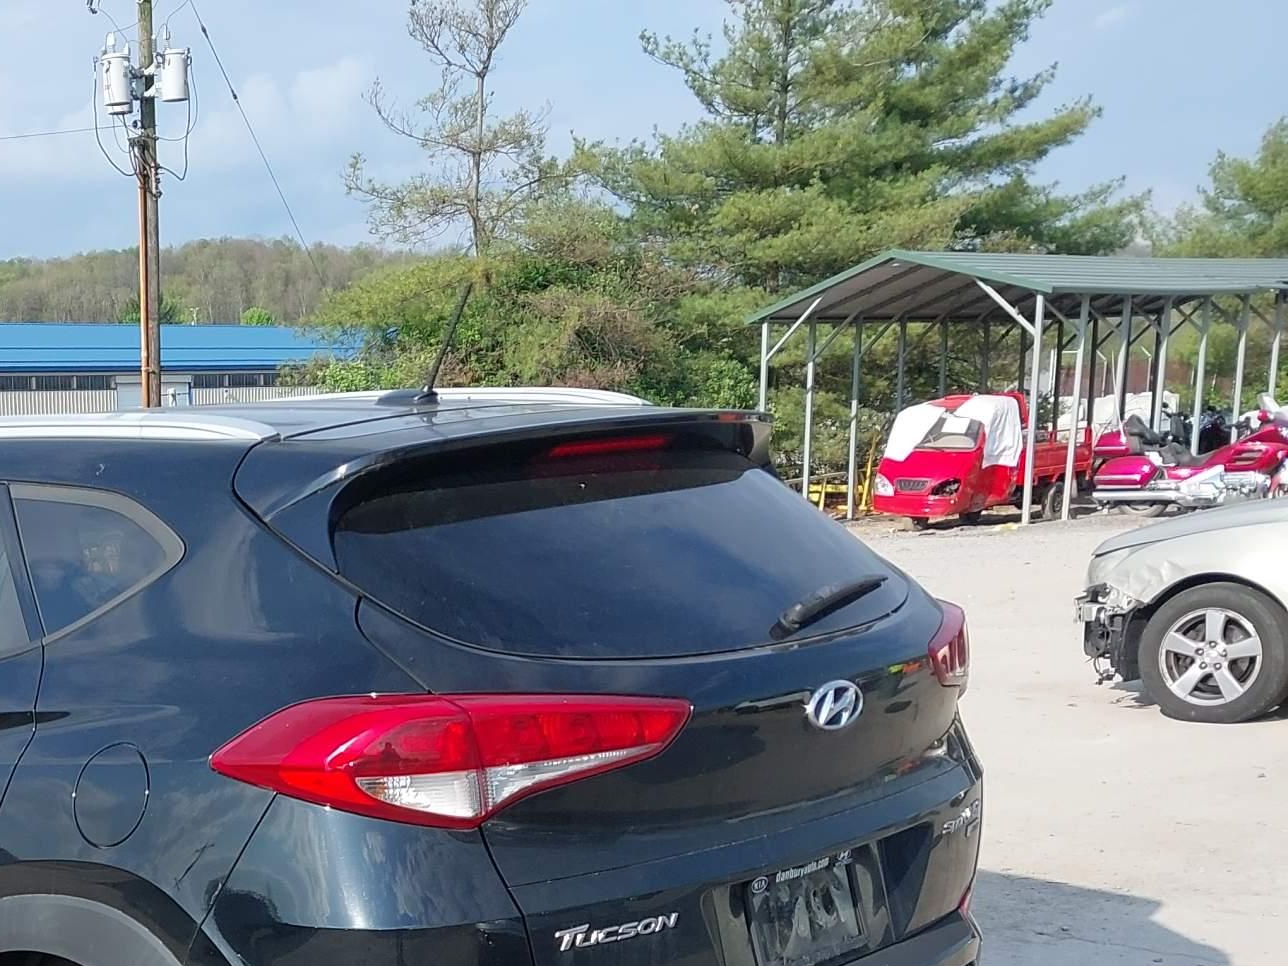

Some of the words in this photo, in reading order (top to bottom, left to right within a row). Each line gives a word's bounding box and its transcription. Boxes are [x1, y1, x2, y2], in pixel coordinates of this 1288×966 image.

[775, 856, 830, 883] danburyauto.com
[754, 880, 766, 890] KIA
[554, 912, 679, 951] TUCSON
